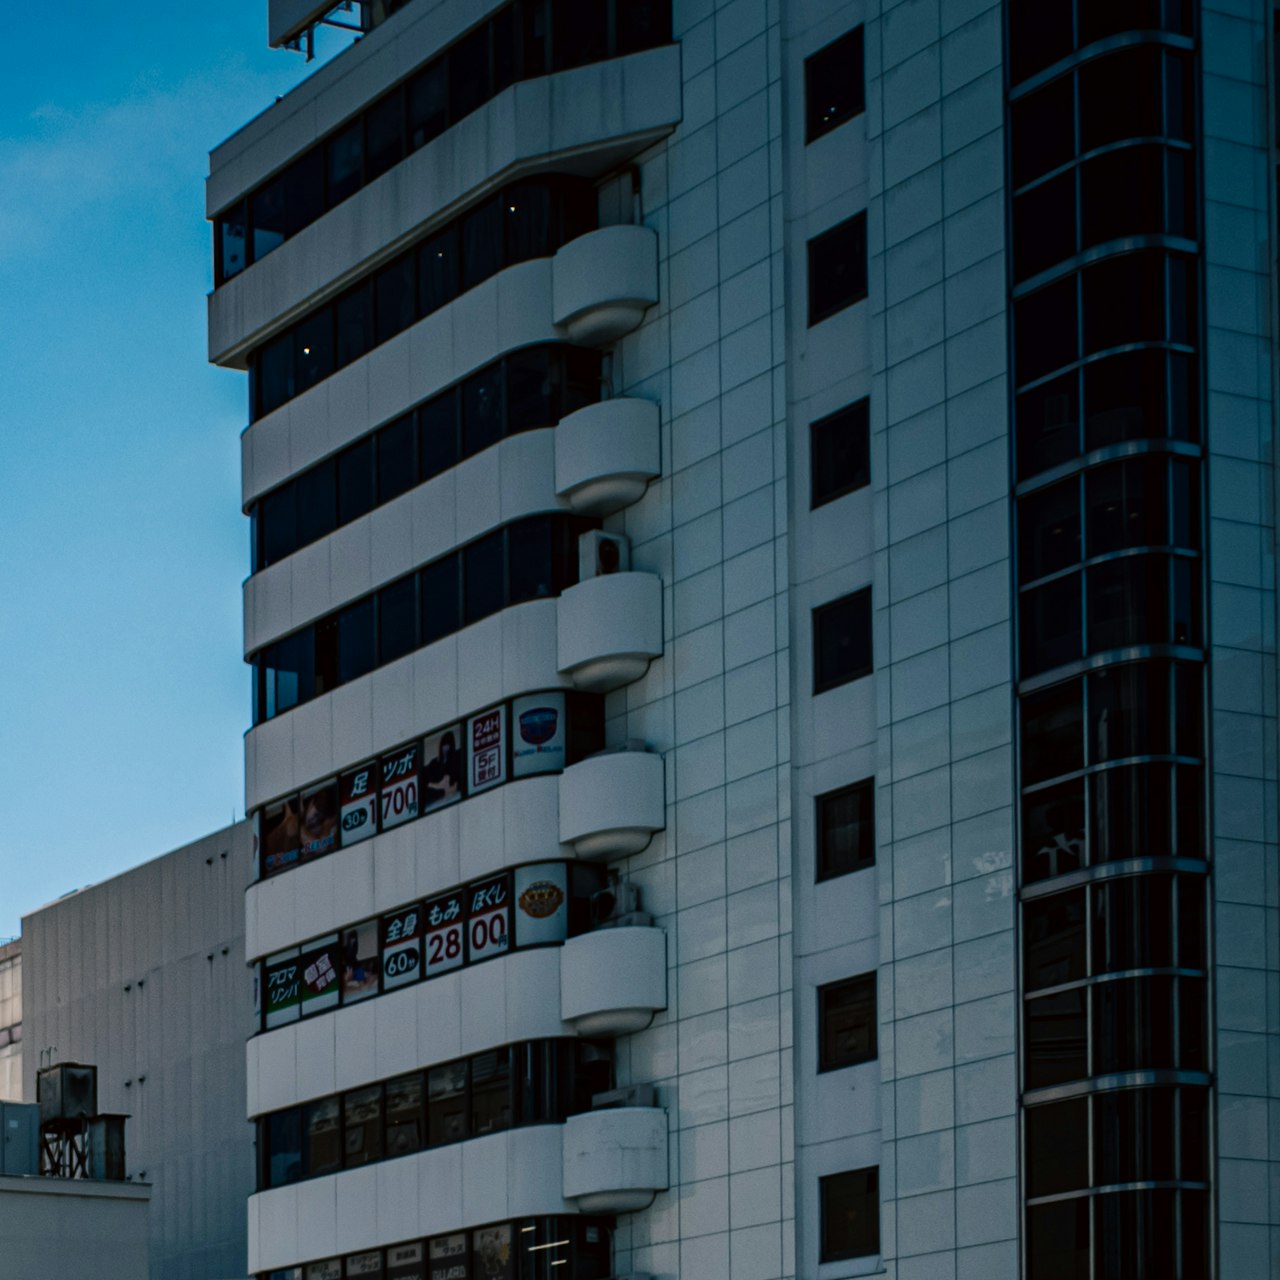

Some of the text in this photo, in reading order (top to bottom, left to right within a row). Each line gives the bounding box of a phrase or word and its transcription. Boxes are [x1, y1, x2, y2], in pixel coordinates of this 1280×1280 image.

[478, 752, 497, 768] 5F
[268, 965, 297, 989] アロマ
